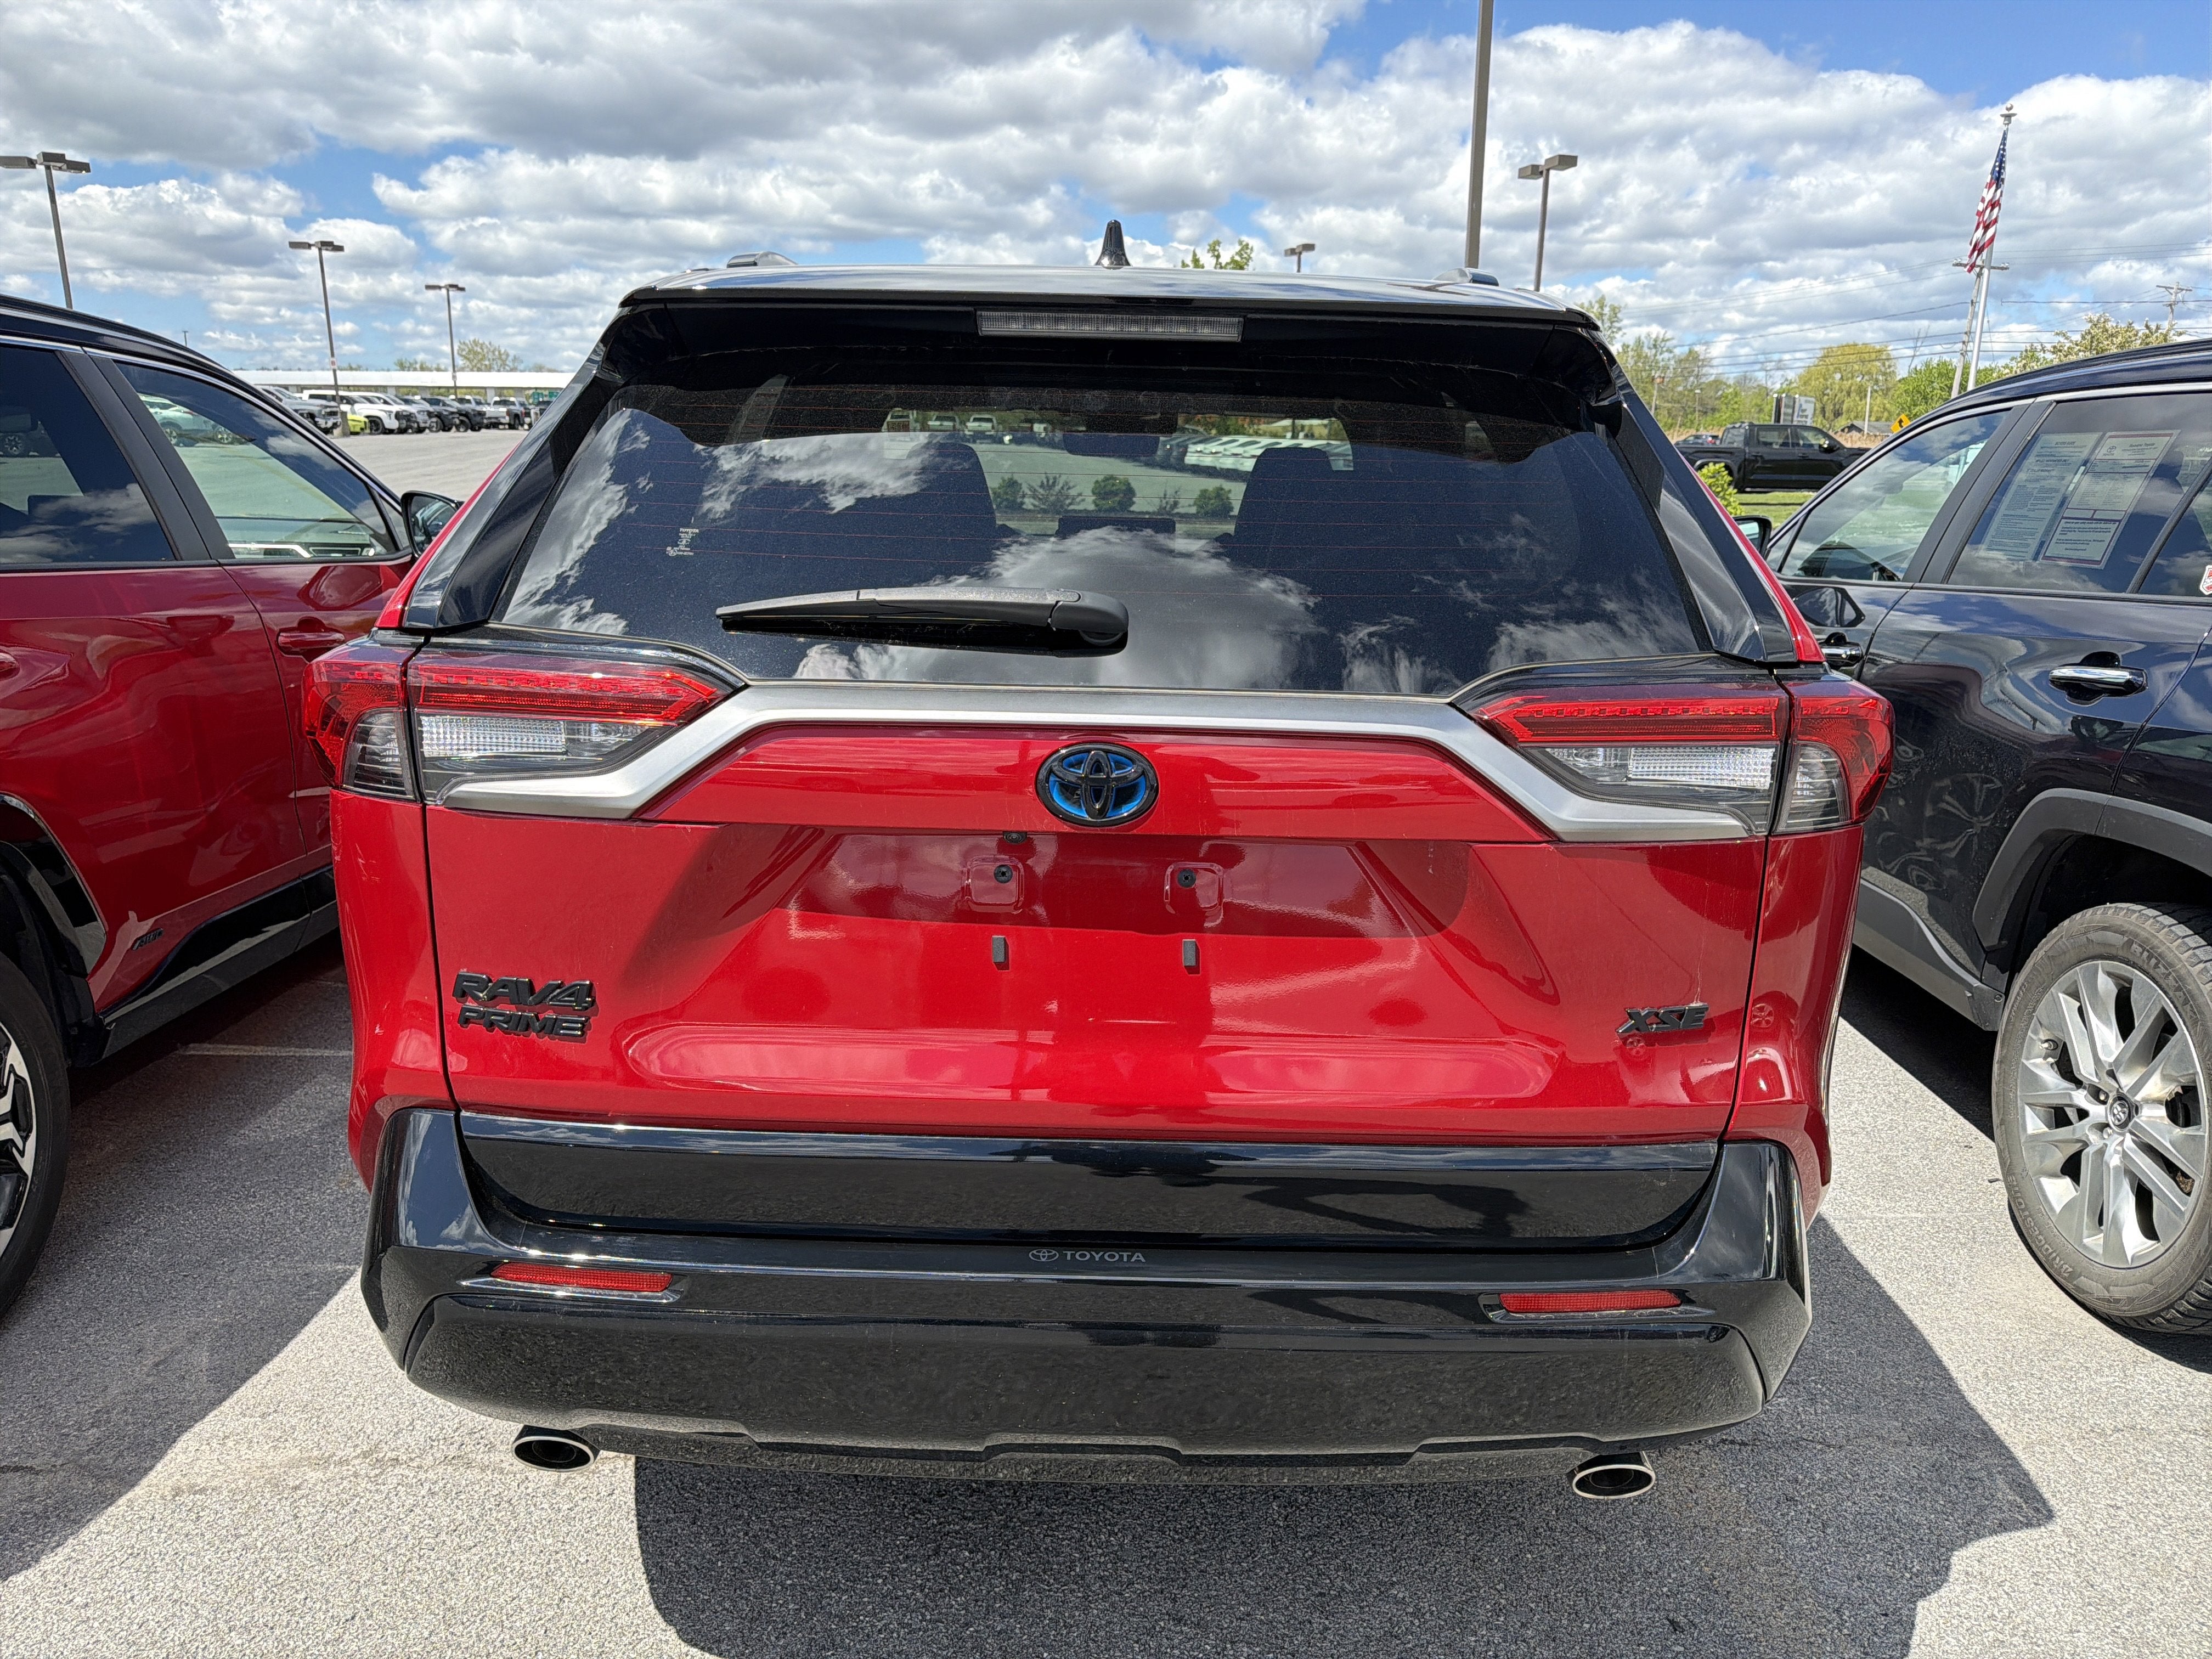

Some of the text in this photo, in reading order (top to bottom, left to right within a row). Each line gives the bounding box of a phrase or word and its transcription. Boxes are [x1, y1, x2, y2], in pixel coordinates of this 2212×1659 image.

[452, 971, 595, 1011] RAV4
[458, 1003, 589, 1037] PRIME
[1615, 1003, 1709, 1034] XSE
[2006, 1175, 2074, 1277] BRIDGESTONE
[1062, 1250, 1146, 1262] TOYOTA
